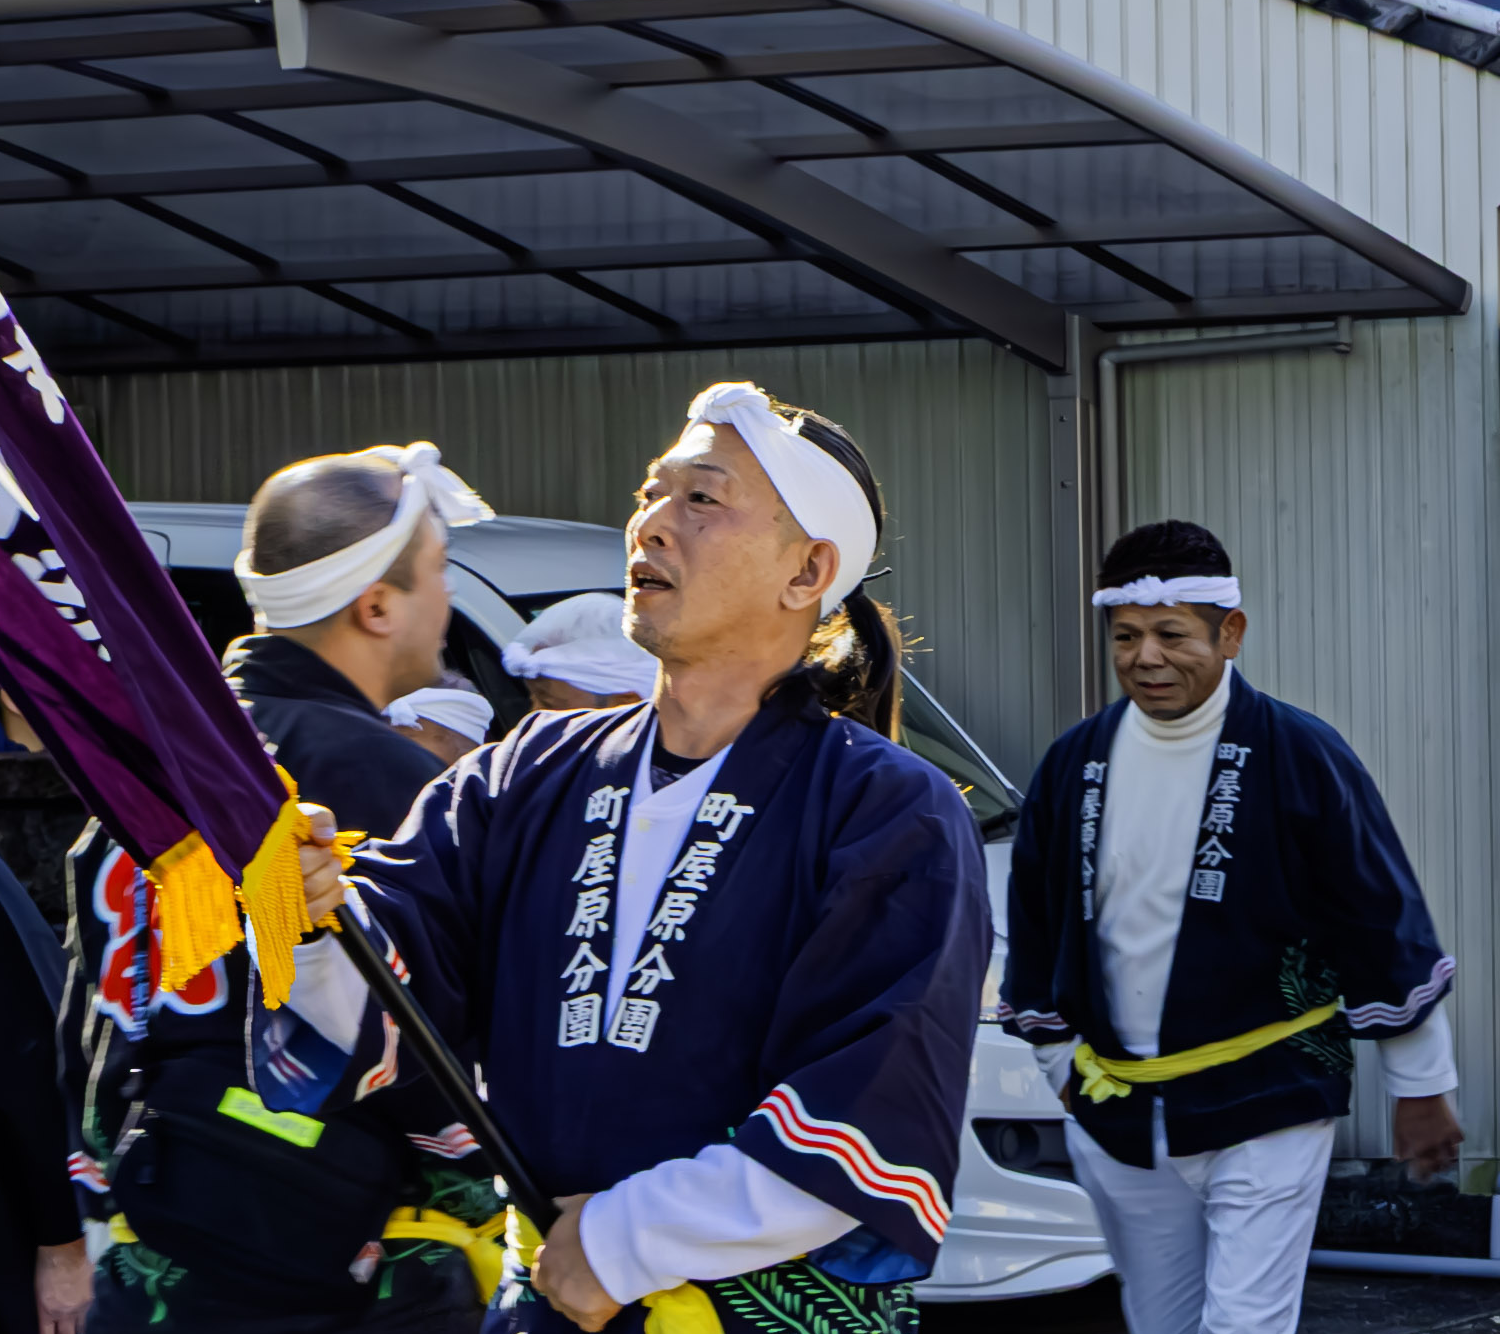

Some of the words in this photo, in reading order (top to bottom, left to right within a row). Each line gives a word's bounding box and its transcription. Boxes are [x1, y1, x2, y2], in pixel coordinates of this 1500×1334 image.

[557, 784, 631, 1048] 町屋原分團
[607, 792, 755, 1053] 町屋原分團
